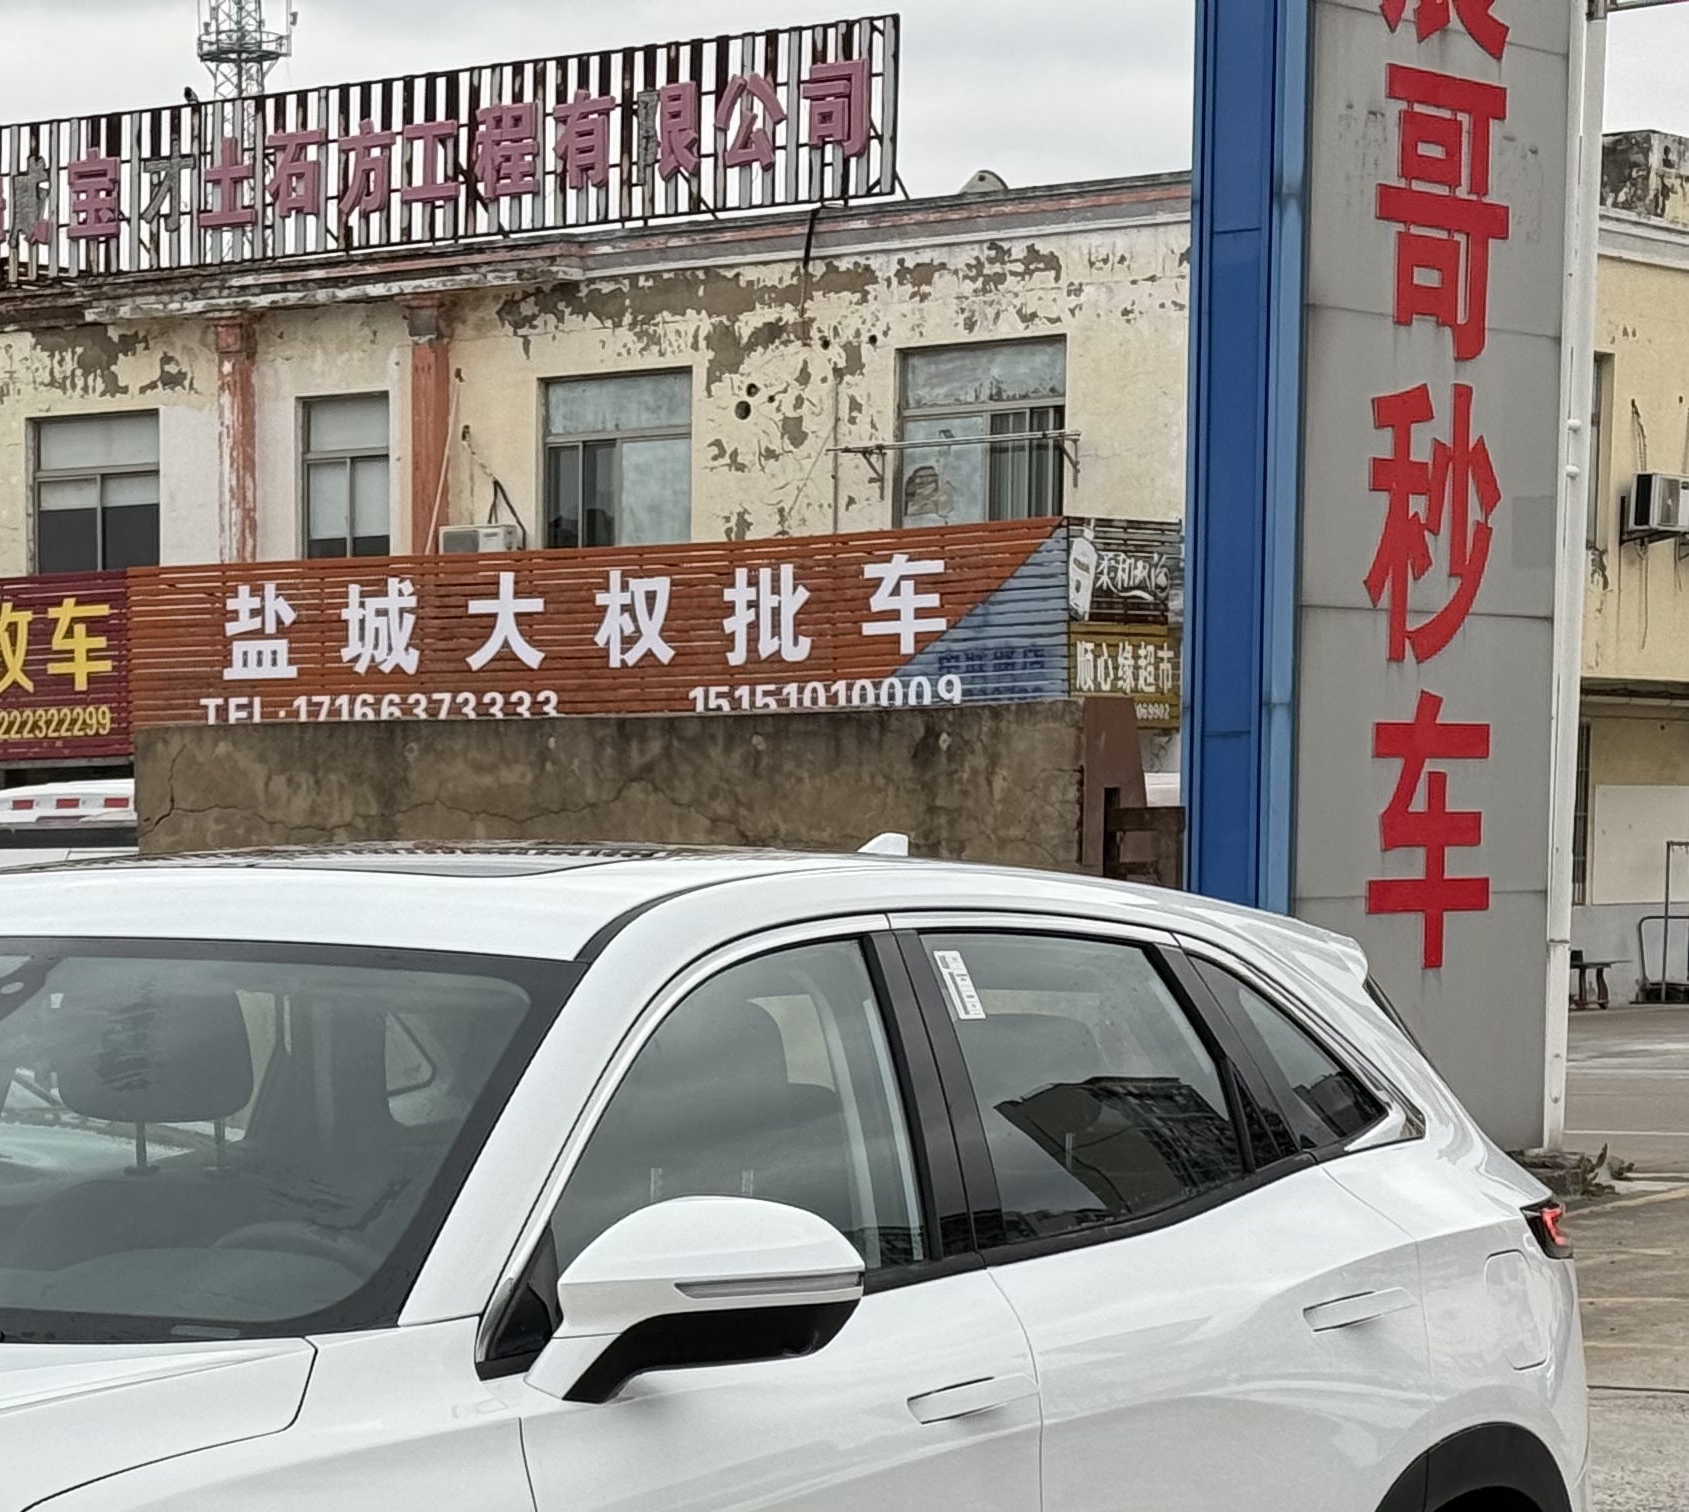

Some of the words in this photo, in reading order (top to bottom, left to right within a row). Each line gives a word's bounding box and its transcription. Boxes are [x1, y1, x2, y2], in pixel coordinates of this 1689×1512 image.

[1365, 0, 1510, 969] 哥秒车
[222, 554, 948, 680] 盐城大权批车
[1076, 640, 1176, 695] 顺心缘超市
[1134, 702, 1171, 720] 069902
